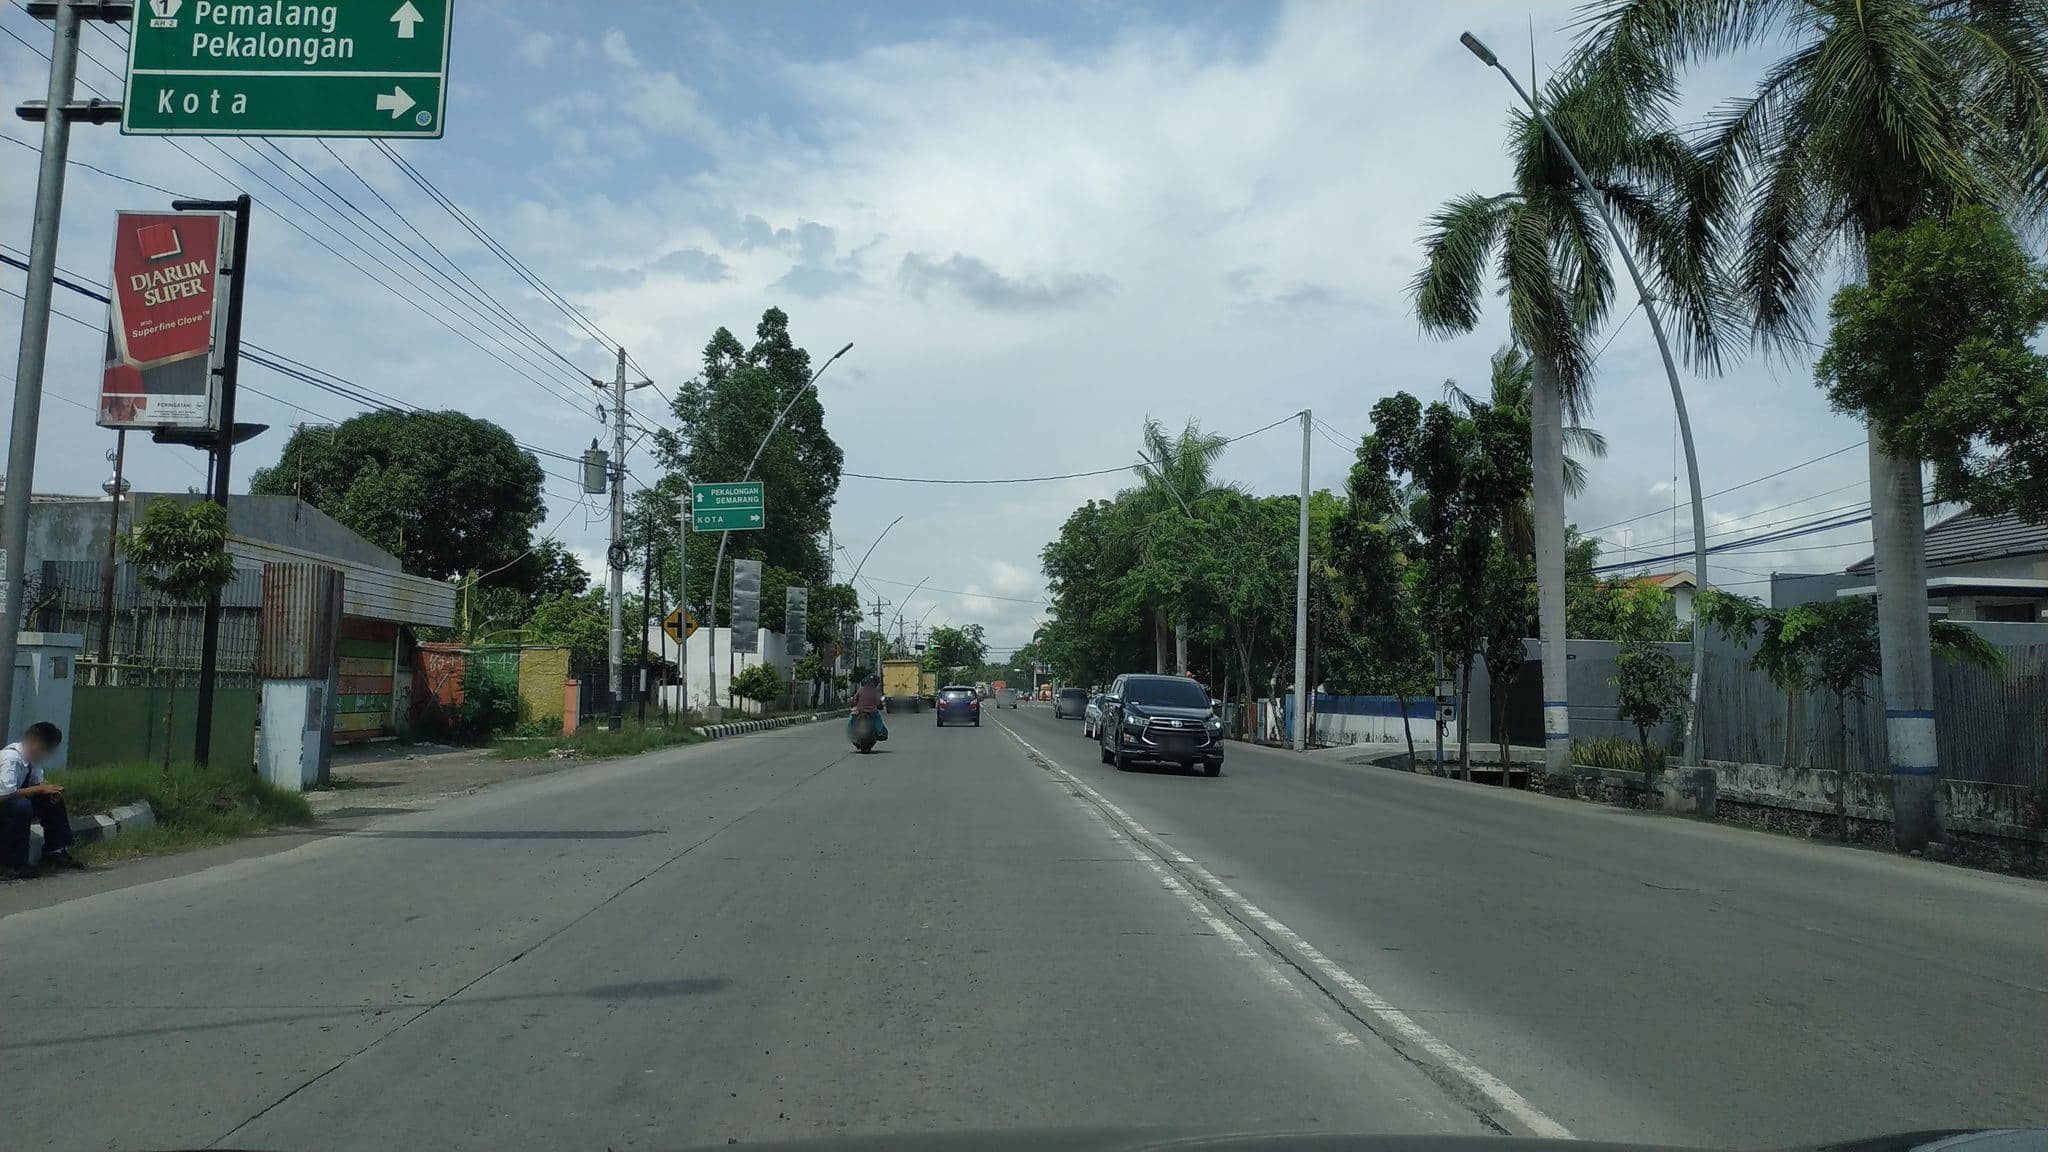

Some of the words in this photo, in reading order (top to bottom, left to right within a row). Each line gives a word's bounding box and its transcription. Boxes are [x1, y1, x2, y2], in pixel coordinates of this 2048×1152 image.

[160, 0, 169, 15] 1
[194, 0, 337, 33] Pemalang
[191, 31, 354, 65] Pekalongan
[158, 89, 248, 114] Kota
[130, 259, 210, 292] DJARUM
[144, 278, 208, 307] SUPER
[131, 322, 176, 338] Superfine
[710, 487, 759, 496] PEKALONGAN
[715, 496, 760, 504] SEMARANG
[697, 516, 724, 524] KOTA
